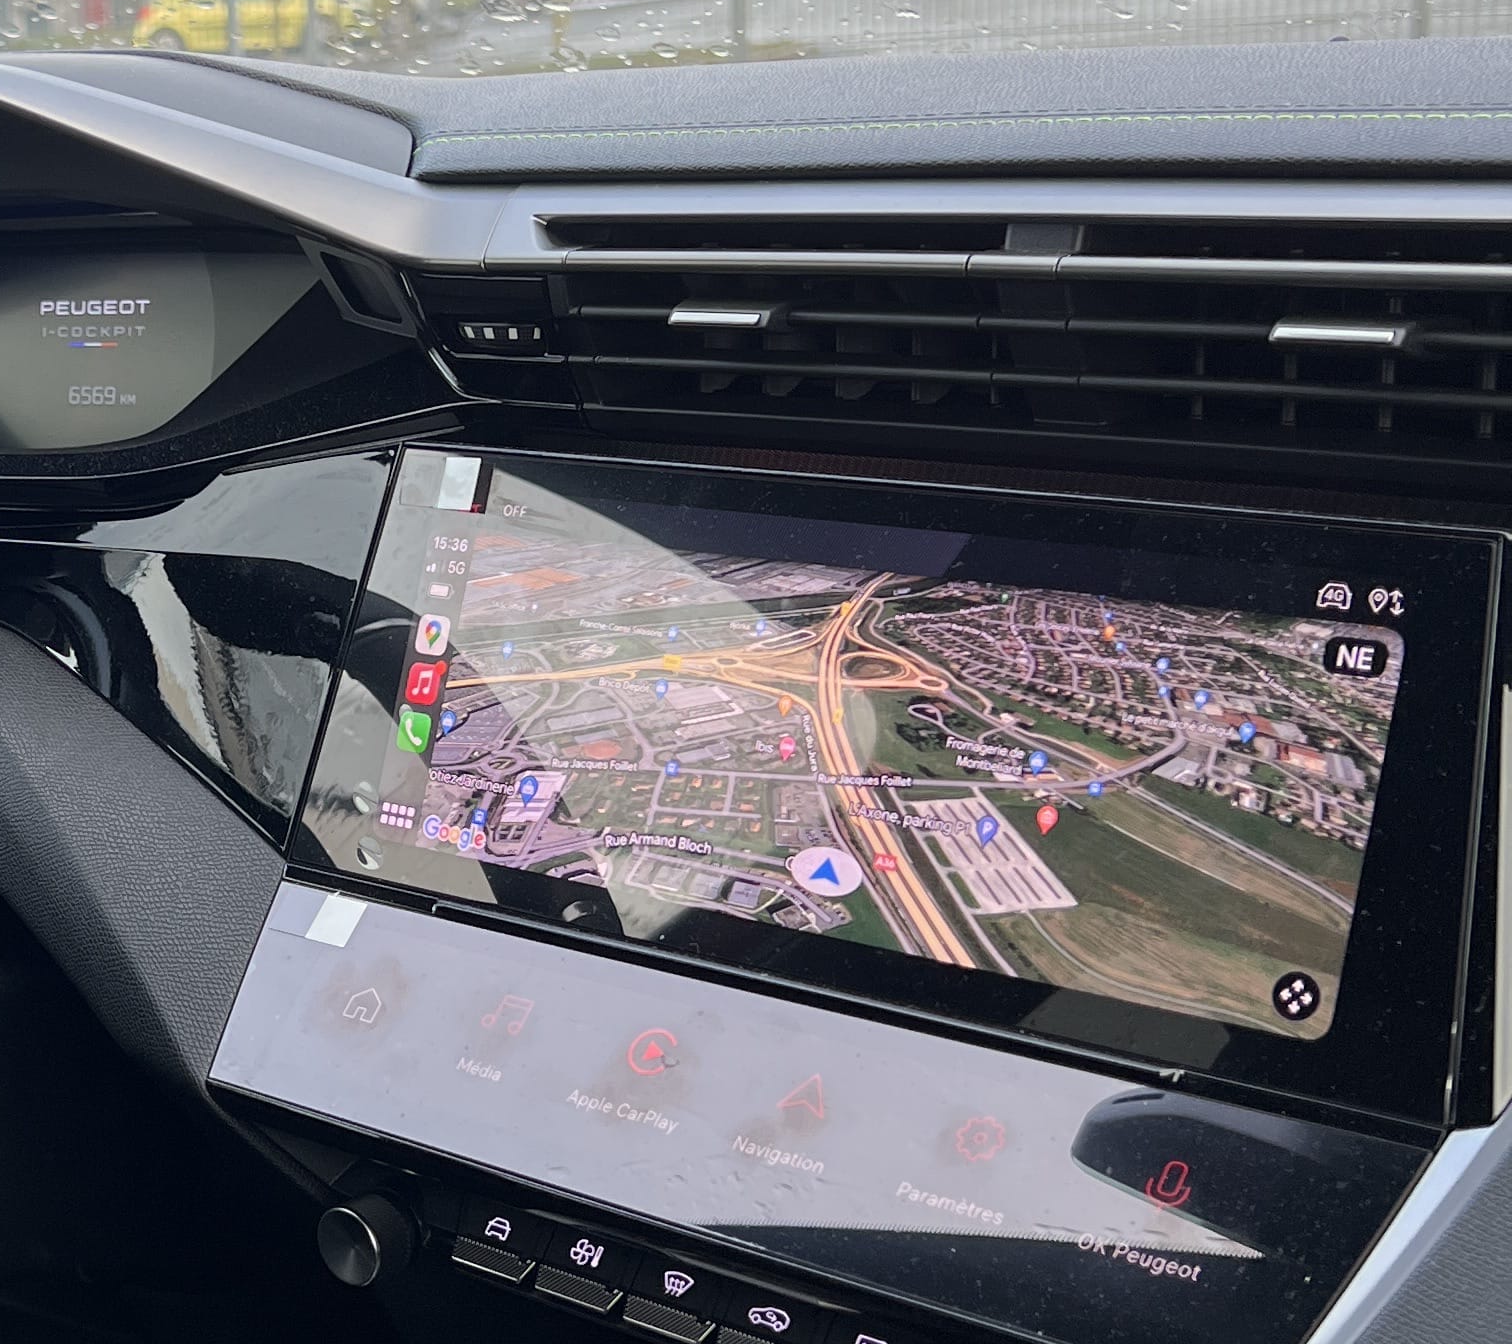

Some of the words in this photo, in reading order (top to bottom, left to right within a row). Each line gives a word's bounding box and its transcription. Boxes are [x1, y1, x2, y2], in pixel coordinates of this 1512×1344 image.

[40, 299, 150, 316] PEUGEOT
[69, 386, 116, 405] 6569
[503, 504, 528, 518] OFF
[433, 536, 469, 552] 15:36
[447, 561, 466, 575] 5G
[1324, 588, 1345, 602] 4G
[1335, 644, 1375, 670] NE
[946, 736, 1009, 756] Fromagerie
[1009, 746, 1026, 759] de
[551, 757, 568, 768] Rue
[569, 759, 608, 771] Jacques
[817, 773, 838, 785] Rue
[838, 774, 880, 787] Jacques
[423, 815, 487, 851] Google
[902, 814, 953, 836] parking
[955, 821, 970, 834] P1
[605, 834, 627, 848] Rue
[629, 832, 677, 850] Armand
[678, 836, 714, 855] Bloch
[456, 1057, 502, 1082] Média
[566, 1088, 614, 1116] Apple
[616, 1102, 679, 1135] CarPlay
[732, 1135, 825, 1174] Navigation
[896, 1181, 1005, 1226] Paramètres
[1077, 1232, 1107, 1256] OK
[1112, 1242, 1203, 1282] Peugeot
